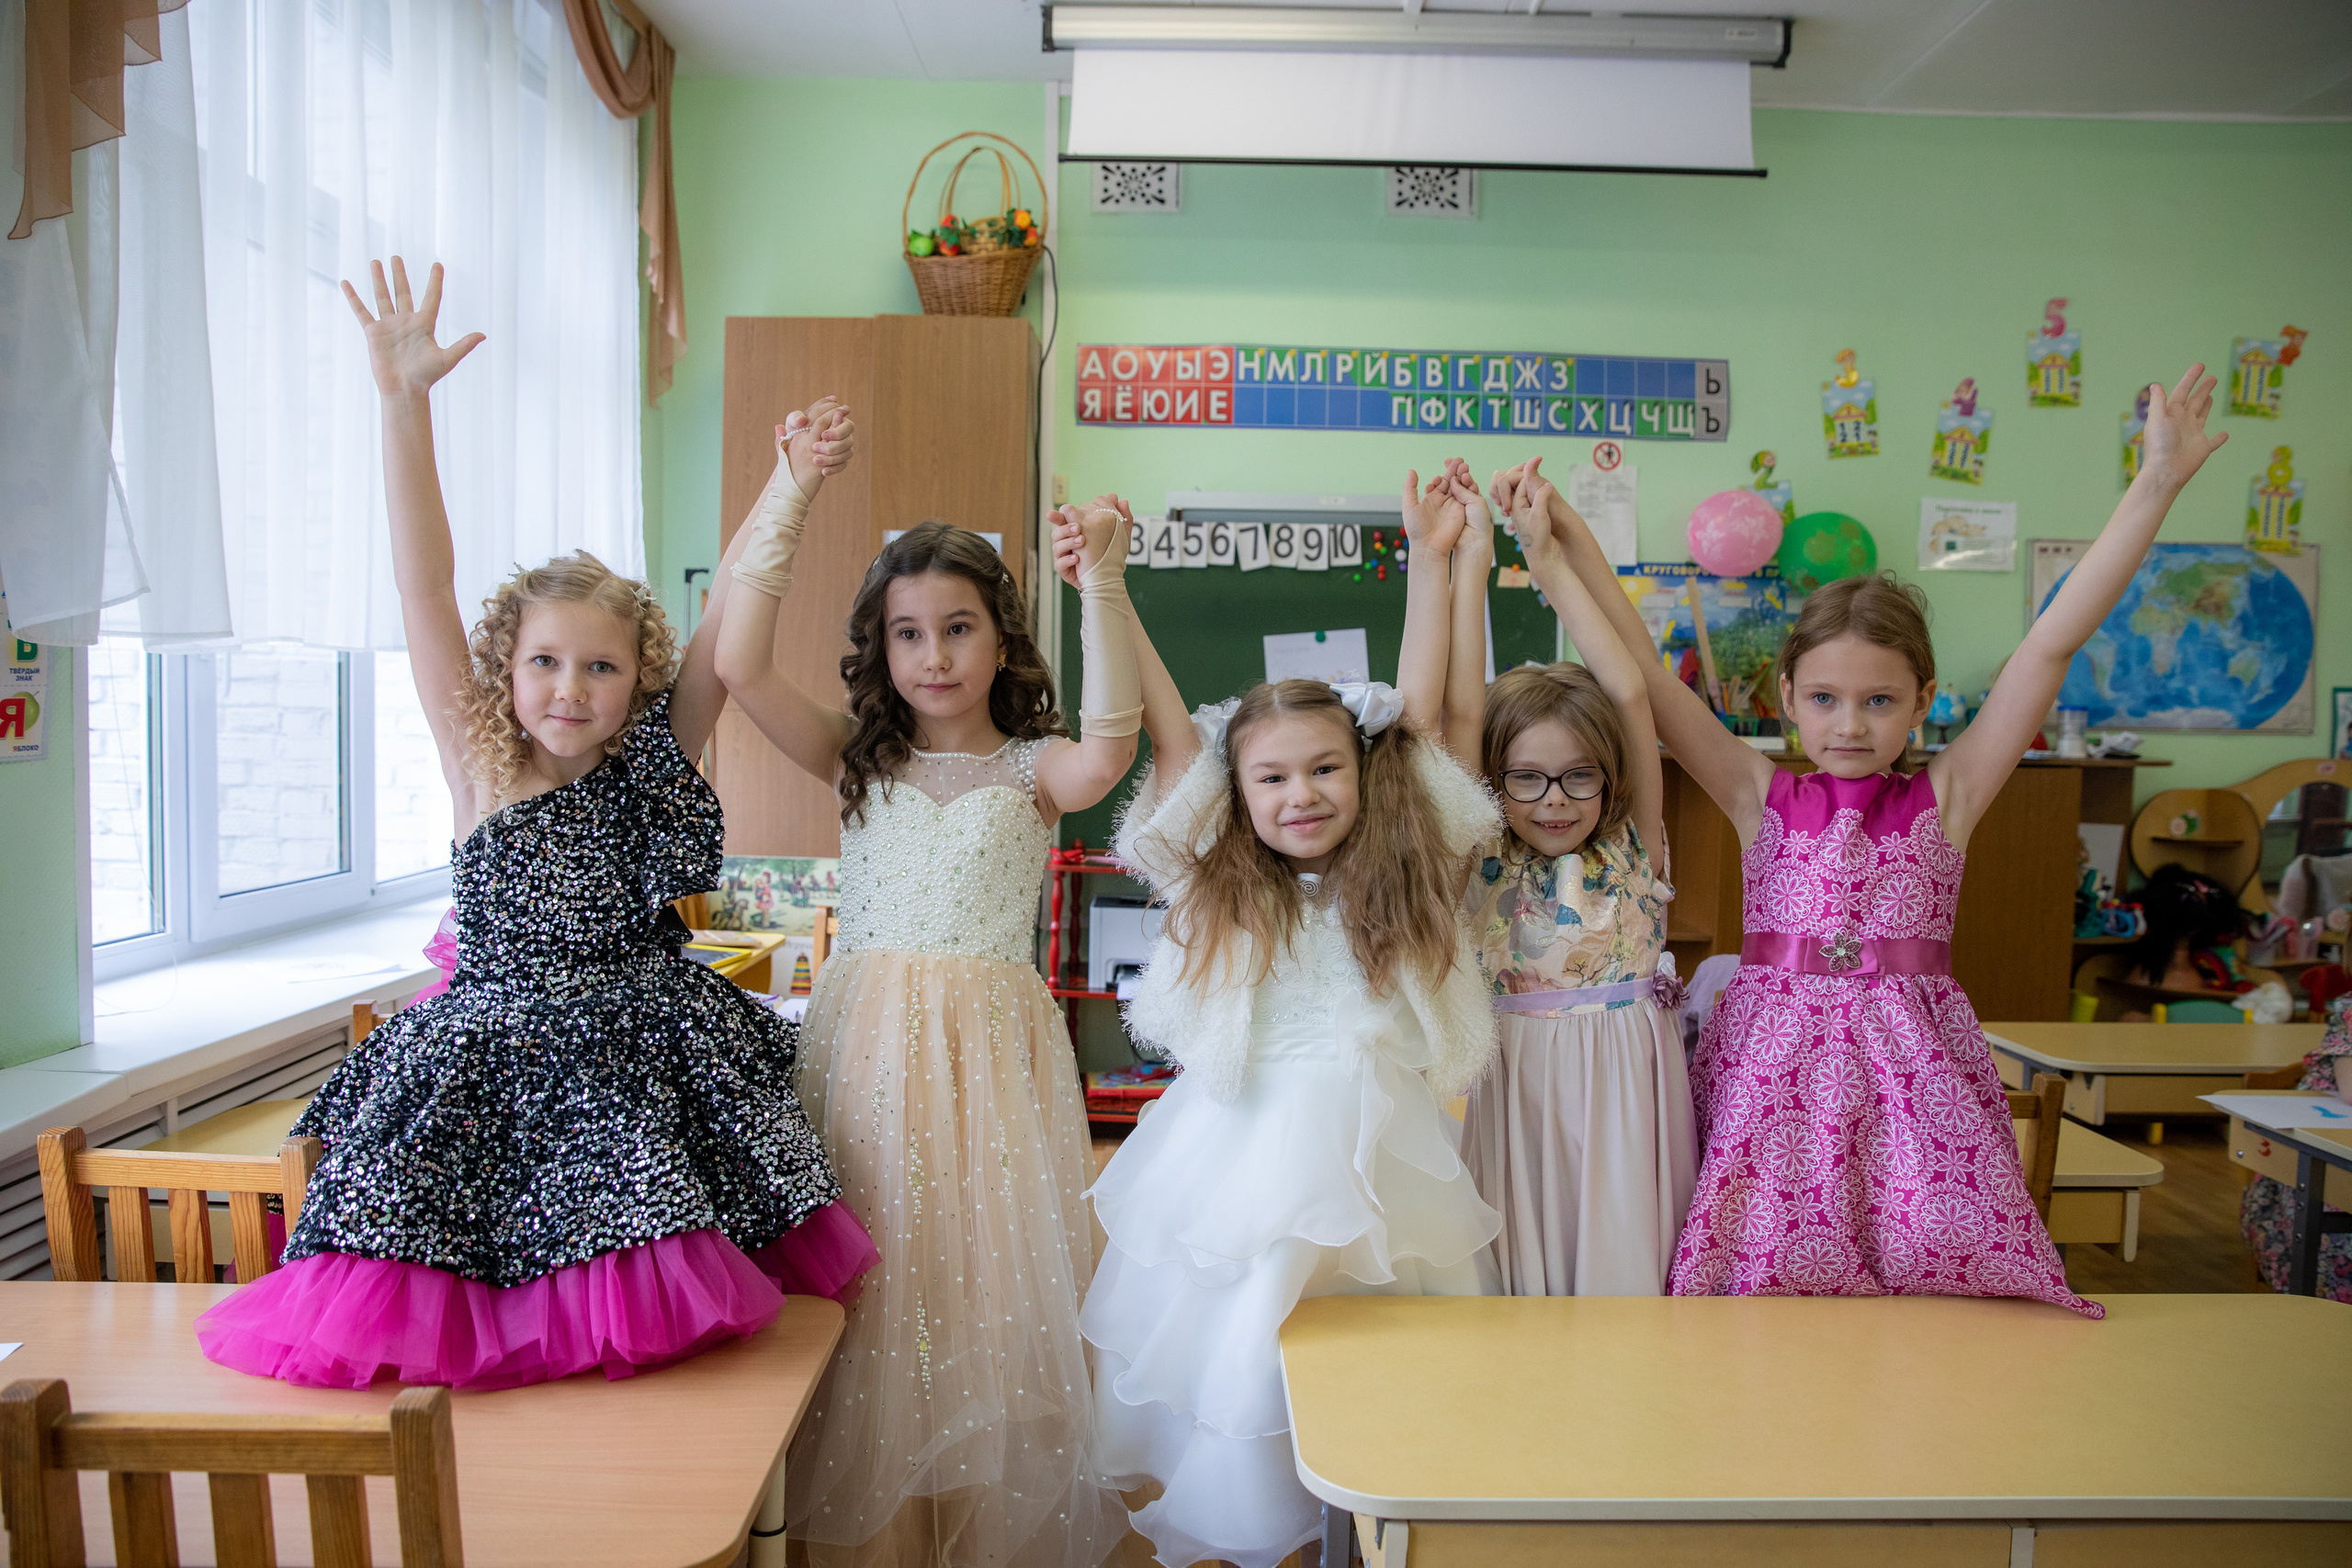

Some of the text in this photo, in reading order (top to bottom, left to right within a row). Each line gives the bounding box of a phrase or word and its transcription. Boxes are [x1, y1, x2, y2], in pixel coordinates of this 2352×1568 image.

[2042, 298, 2069, 339] 5
[1129, 522, 1358, 561] 3 4 5 6 7 8 9 10
[0, 698, 26, 738] Я
